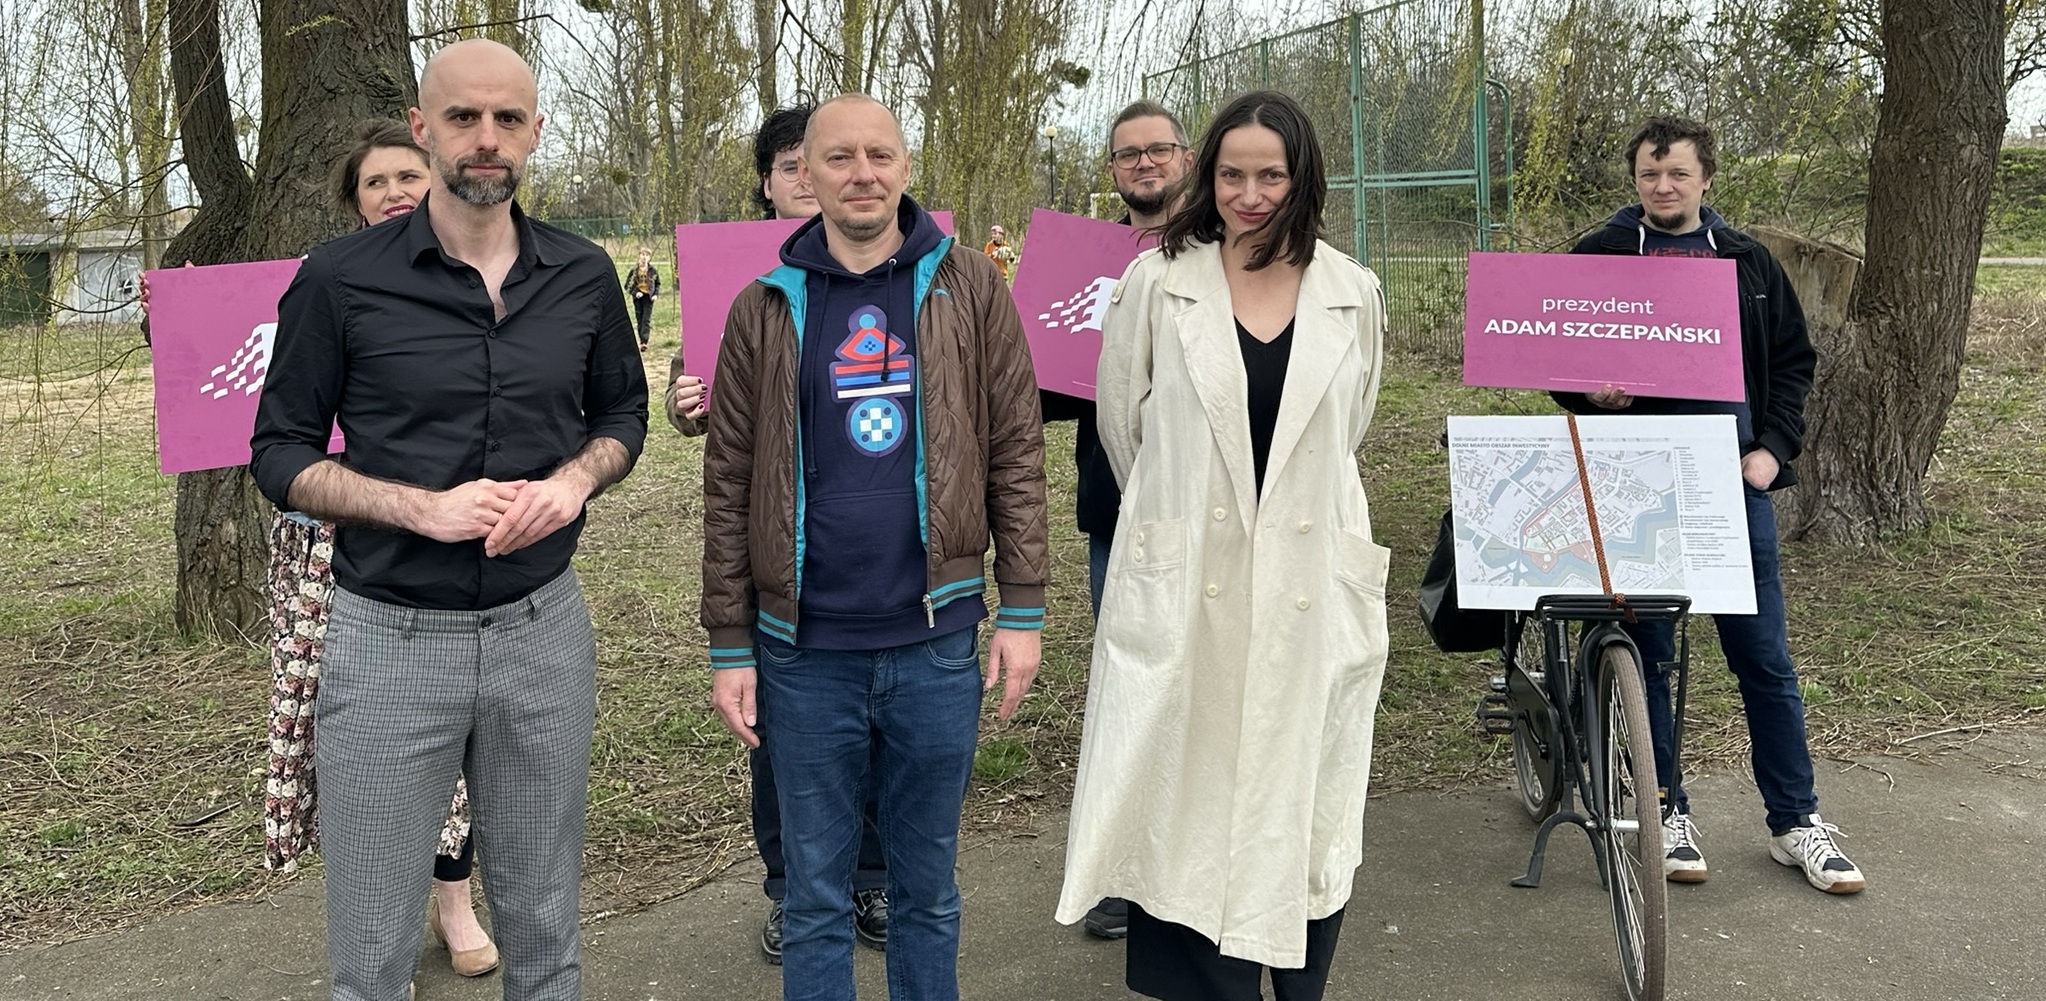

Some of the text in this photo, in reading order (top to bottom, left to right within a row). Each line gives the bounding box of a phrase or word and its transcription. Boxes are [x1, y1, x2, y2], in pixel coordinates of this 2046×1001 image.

[1542, 297, 1653, 315] prezydent
[1484, 319, 1720, 343] ADAM SZCZEPAŃSKI
